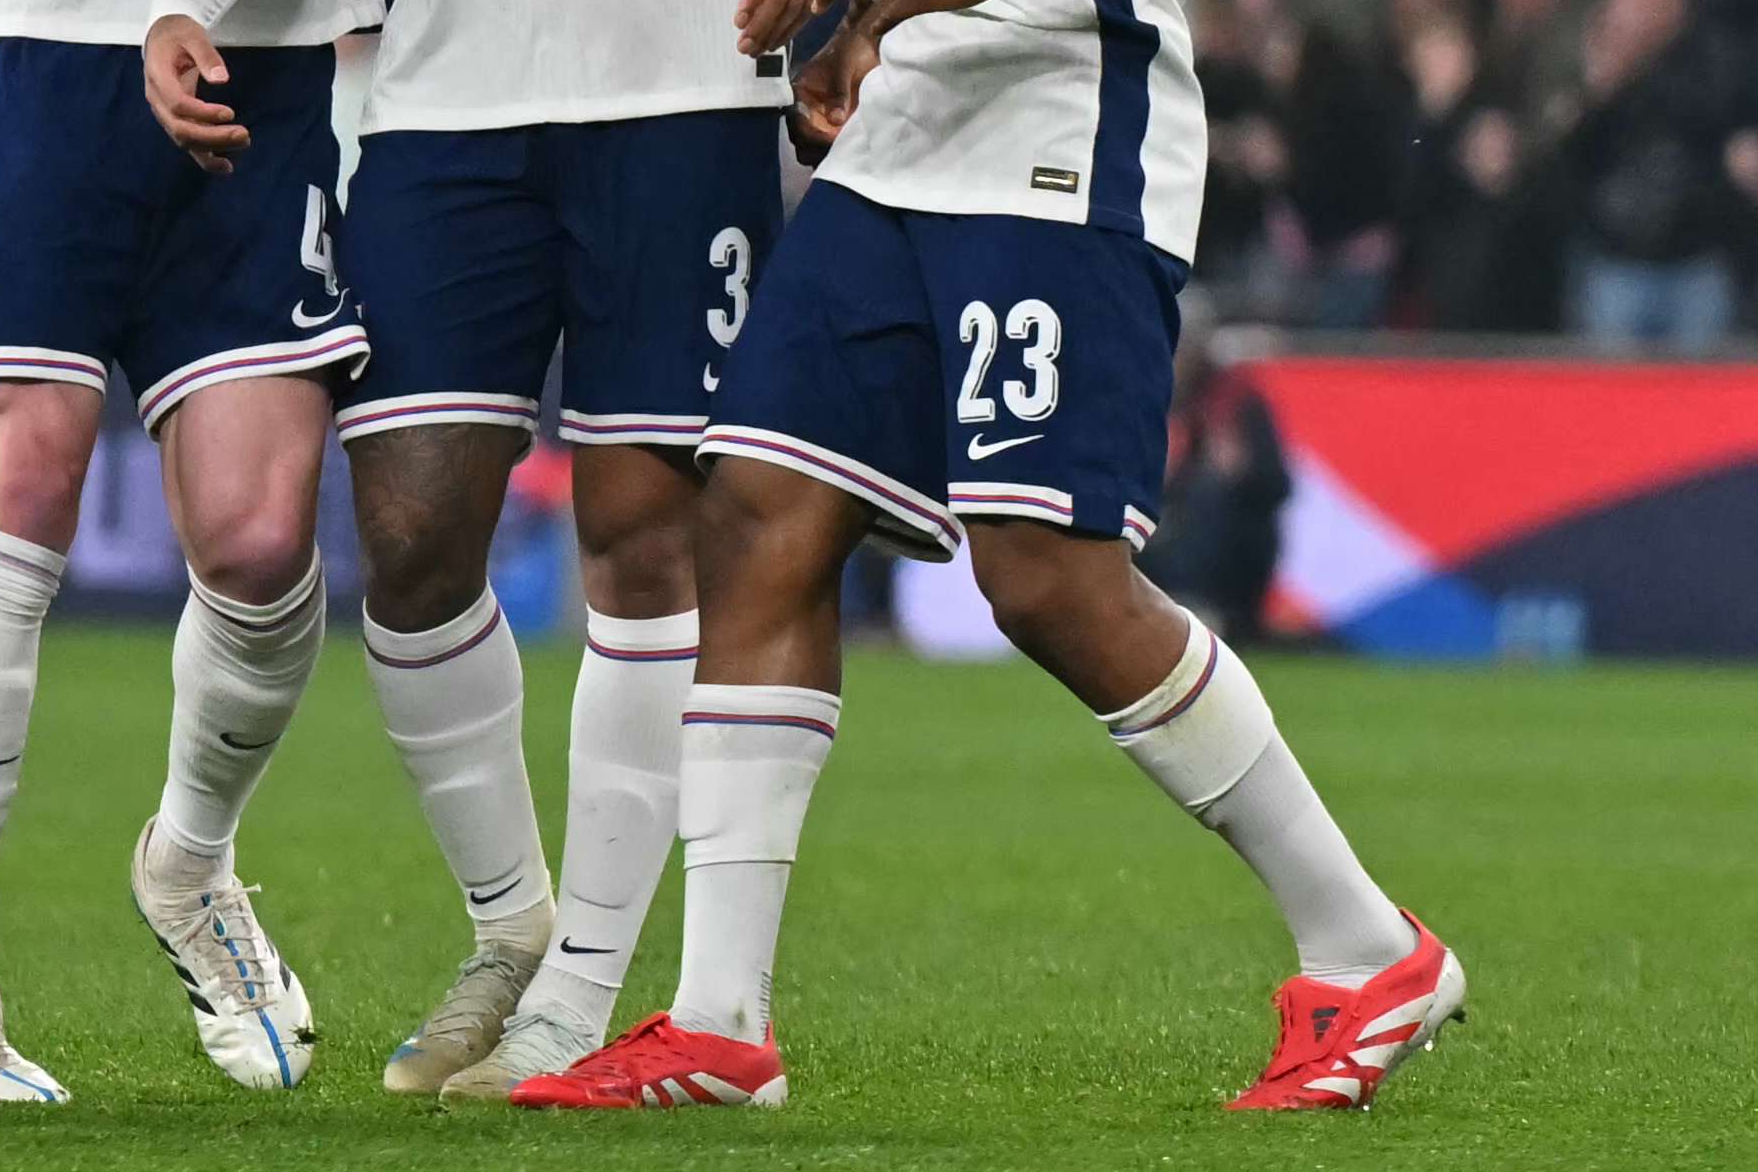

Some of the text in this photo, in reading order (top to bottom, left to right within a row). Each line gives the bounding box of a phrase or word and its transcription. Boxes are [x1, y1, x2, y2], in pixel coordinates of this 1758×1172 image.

[301, 183, 339, 296] 4
[707, 227, 751, 348] 3
[957, 299, 1061, 423] 23
